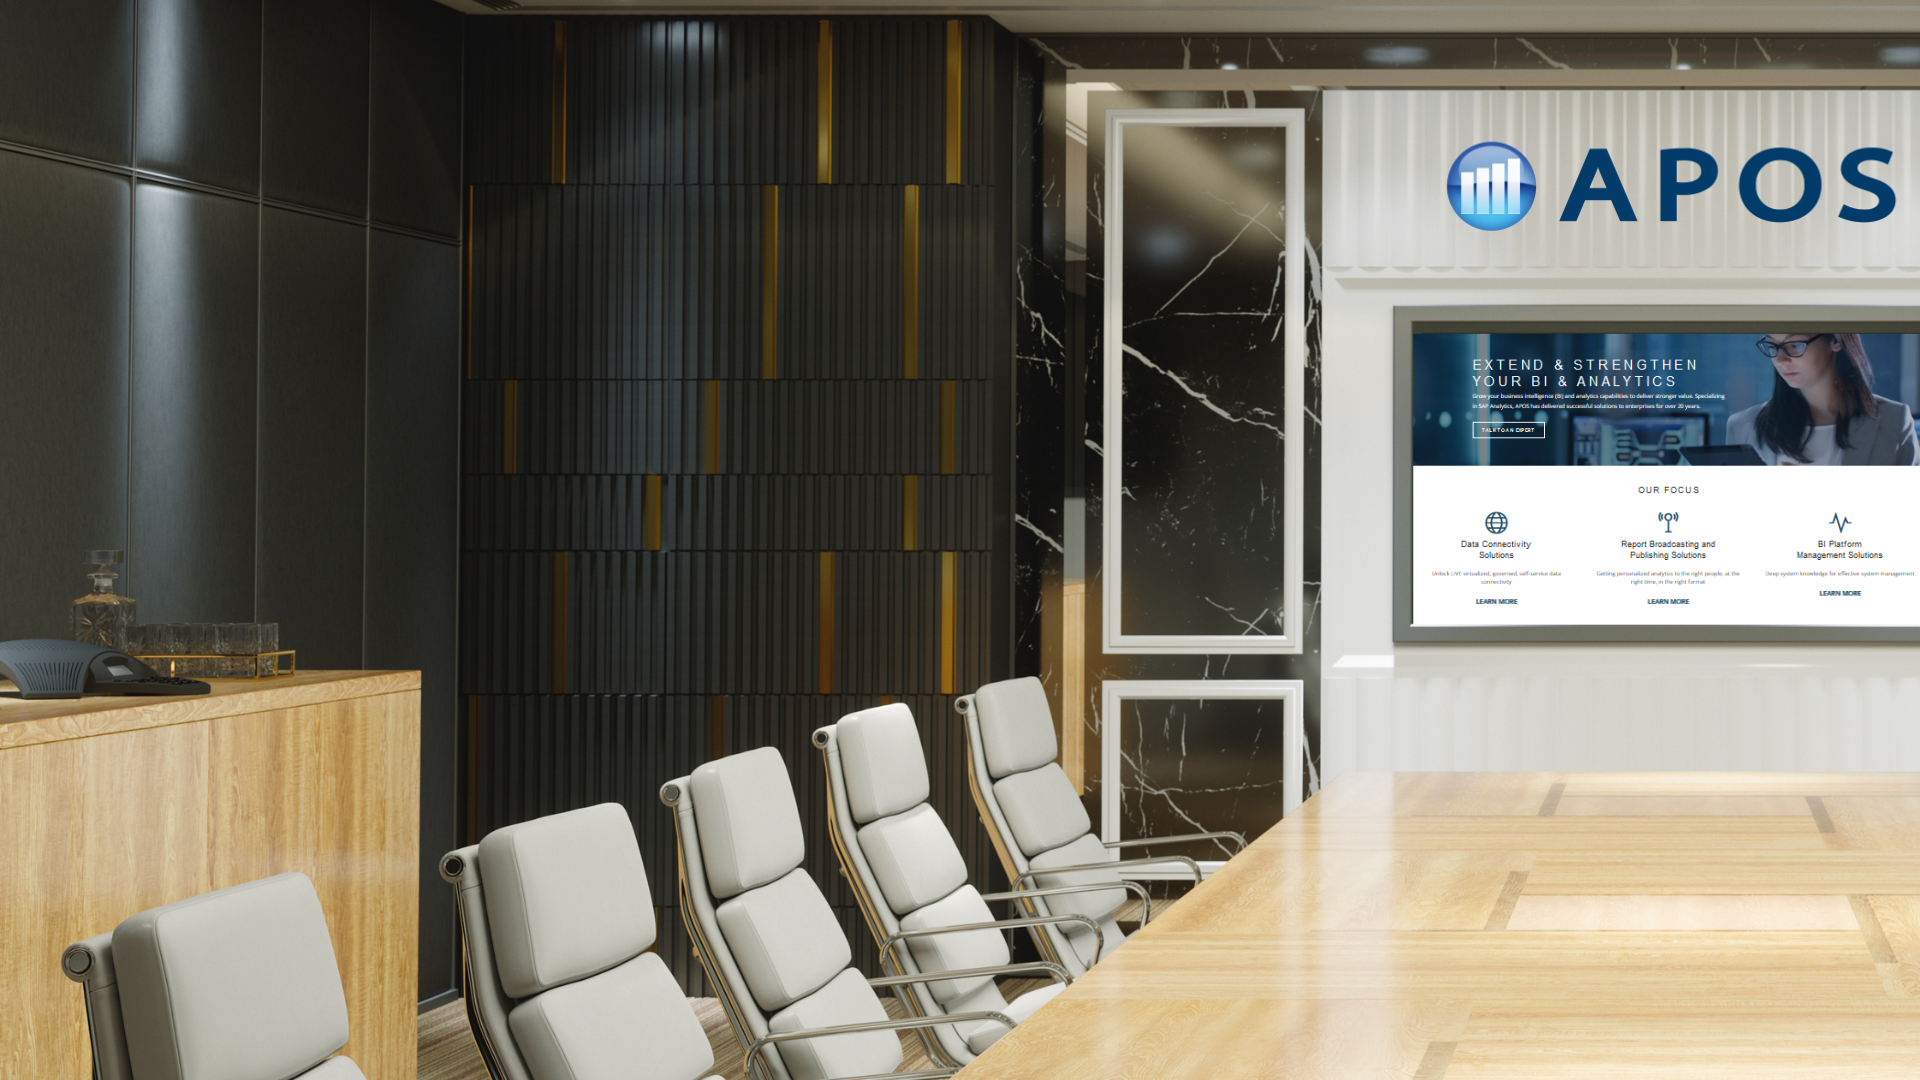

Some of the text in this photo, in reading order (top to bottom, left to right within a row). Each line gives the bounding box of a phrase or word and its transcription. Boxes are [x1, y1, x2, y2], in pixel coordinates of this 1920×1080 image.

[1559, 147, 1896, 222] APOS
[1473, 359, 1697, 371] EXTEND & STRENGTHEN
[1472, 375, 1675, 387] YOUR BI & ANALYTICS
[1481, 540, 1531, 549] Connectivity
[1621, 540, 1647, 549] Report
[1649, 540, 1699, 549] Broadcasting
[1630, 551, 1669, 560] Publishing
[1797, 551, 1846, 560] Management
